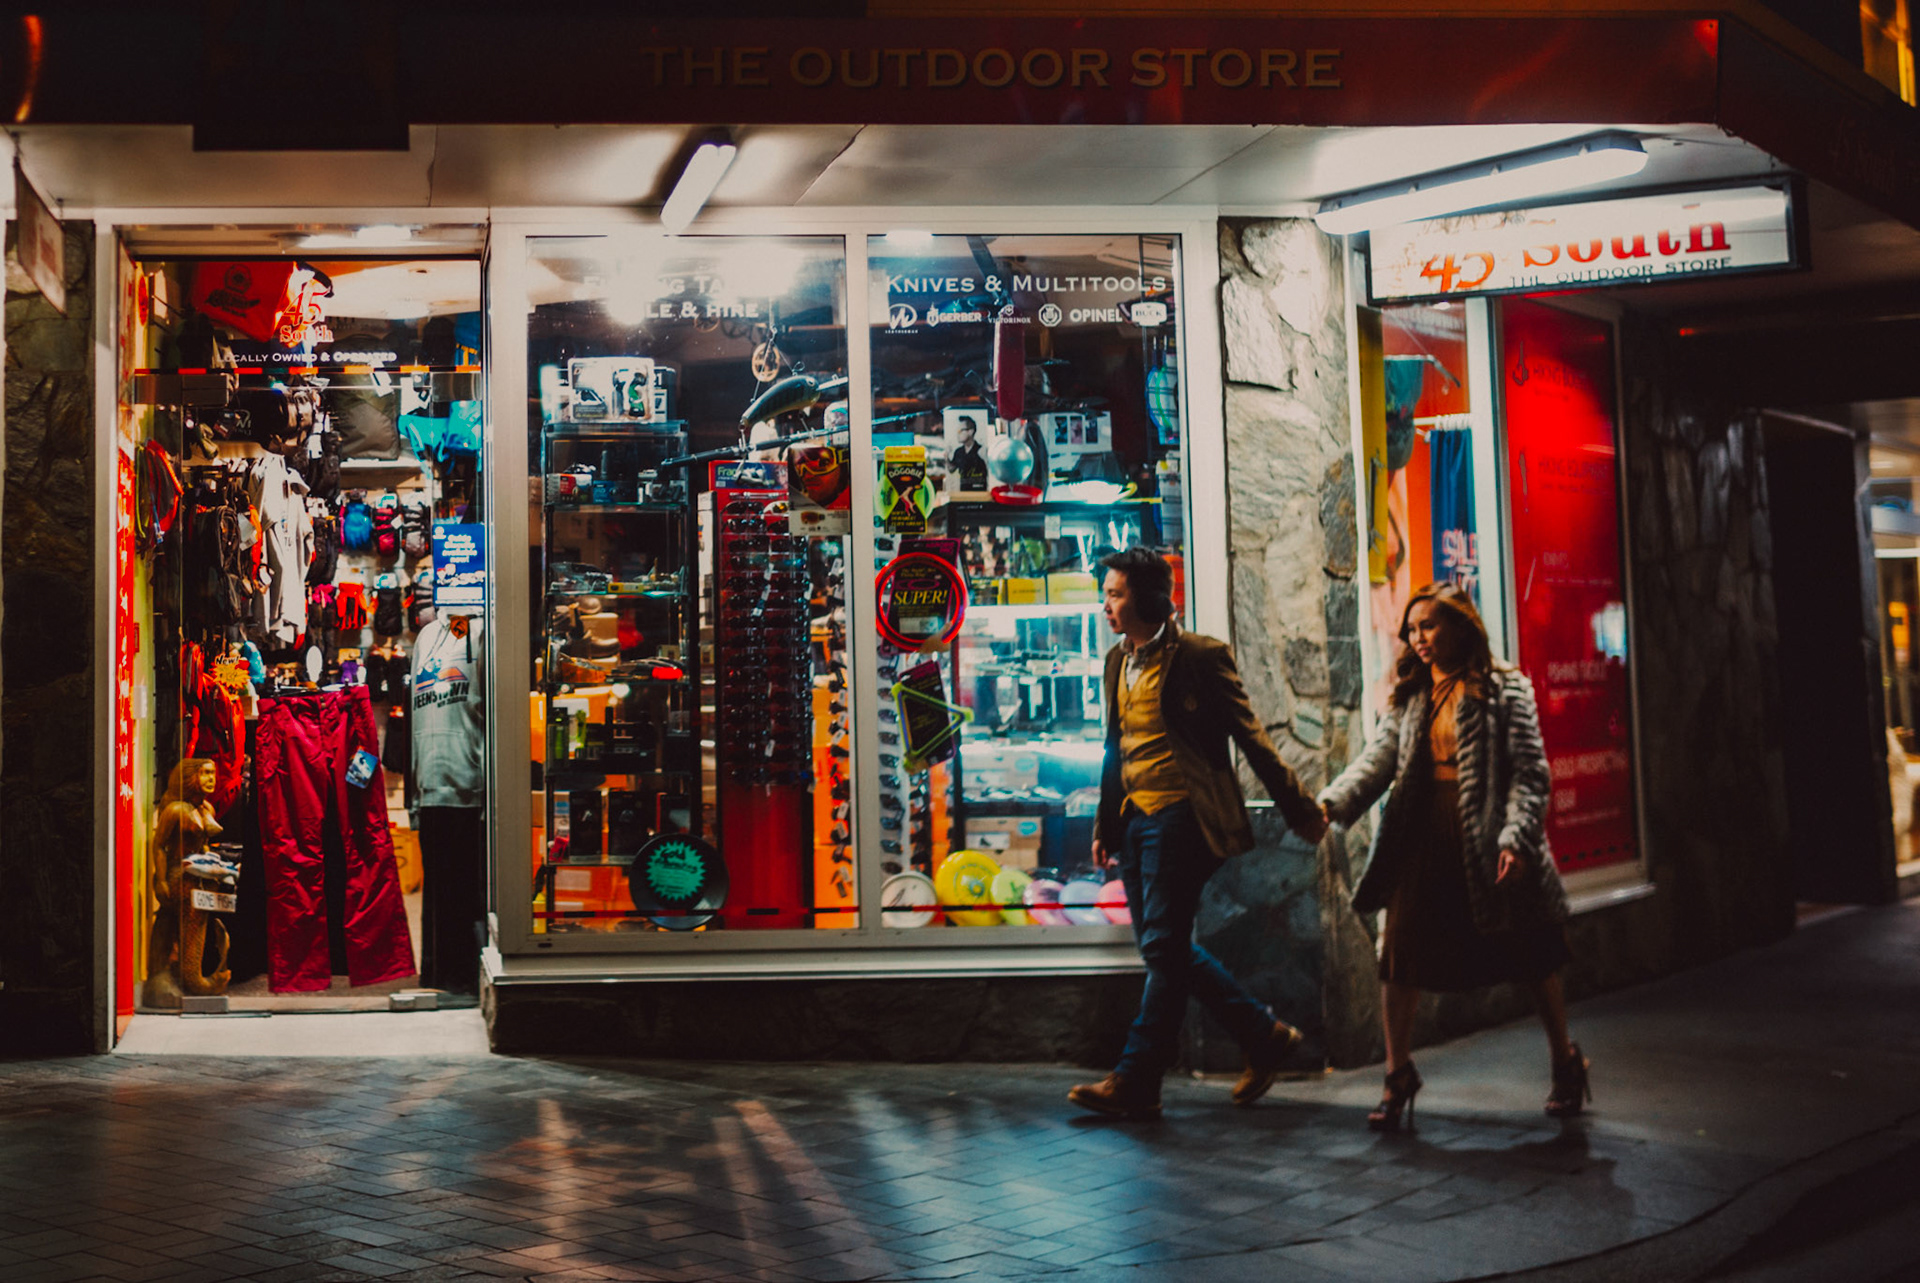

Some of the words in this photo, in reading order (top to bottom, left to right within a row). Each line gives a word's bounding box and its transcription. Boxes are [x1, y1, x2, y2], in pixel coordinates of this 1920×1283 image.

[641, 46, 770, 87] THE
[789, 47, 1110, 88] OUTDOOR
[1131, 48, 1343, 88] STORE
[1556, 264, 1655, 284] OUTDOOR
[1665, 256, 1733, 274] STORE
[886, 275, 975, 293] KNIVES
[984, 275, 1002, 292] &
[1013, 275, 1166, 292] MULTITOOLS
[281, 288, 330, 326] 45
[681, 301, 699, 318] &
[707, 303, 759, 318] HIRE
[939, 311, 982, 323] GERBER
[1069, 307, 1123, 323] OPINEL
[216, 353, 269, 363] LOCALLY
[893, 589, 948, 605] SUPER!
